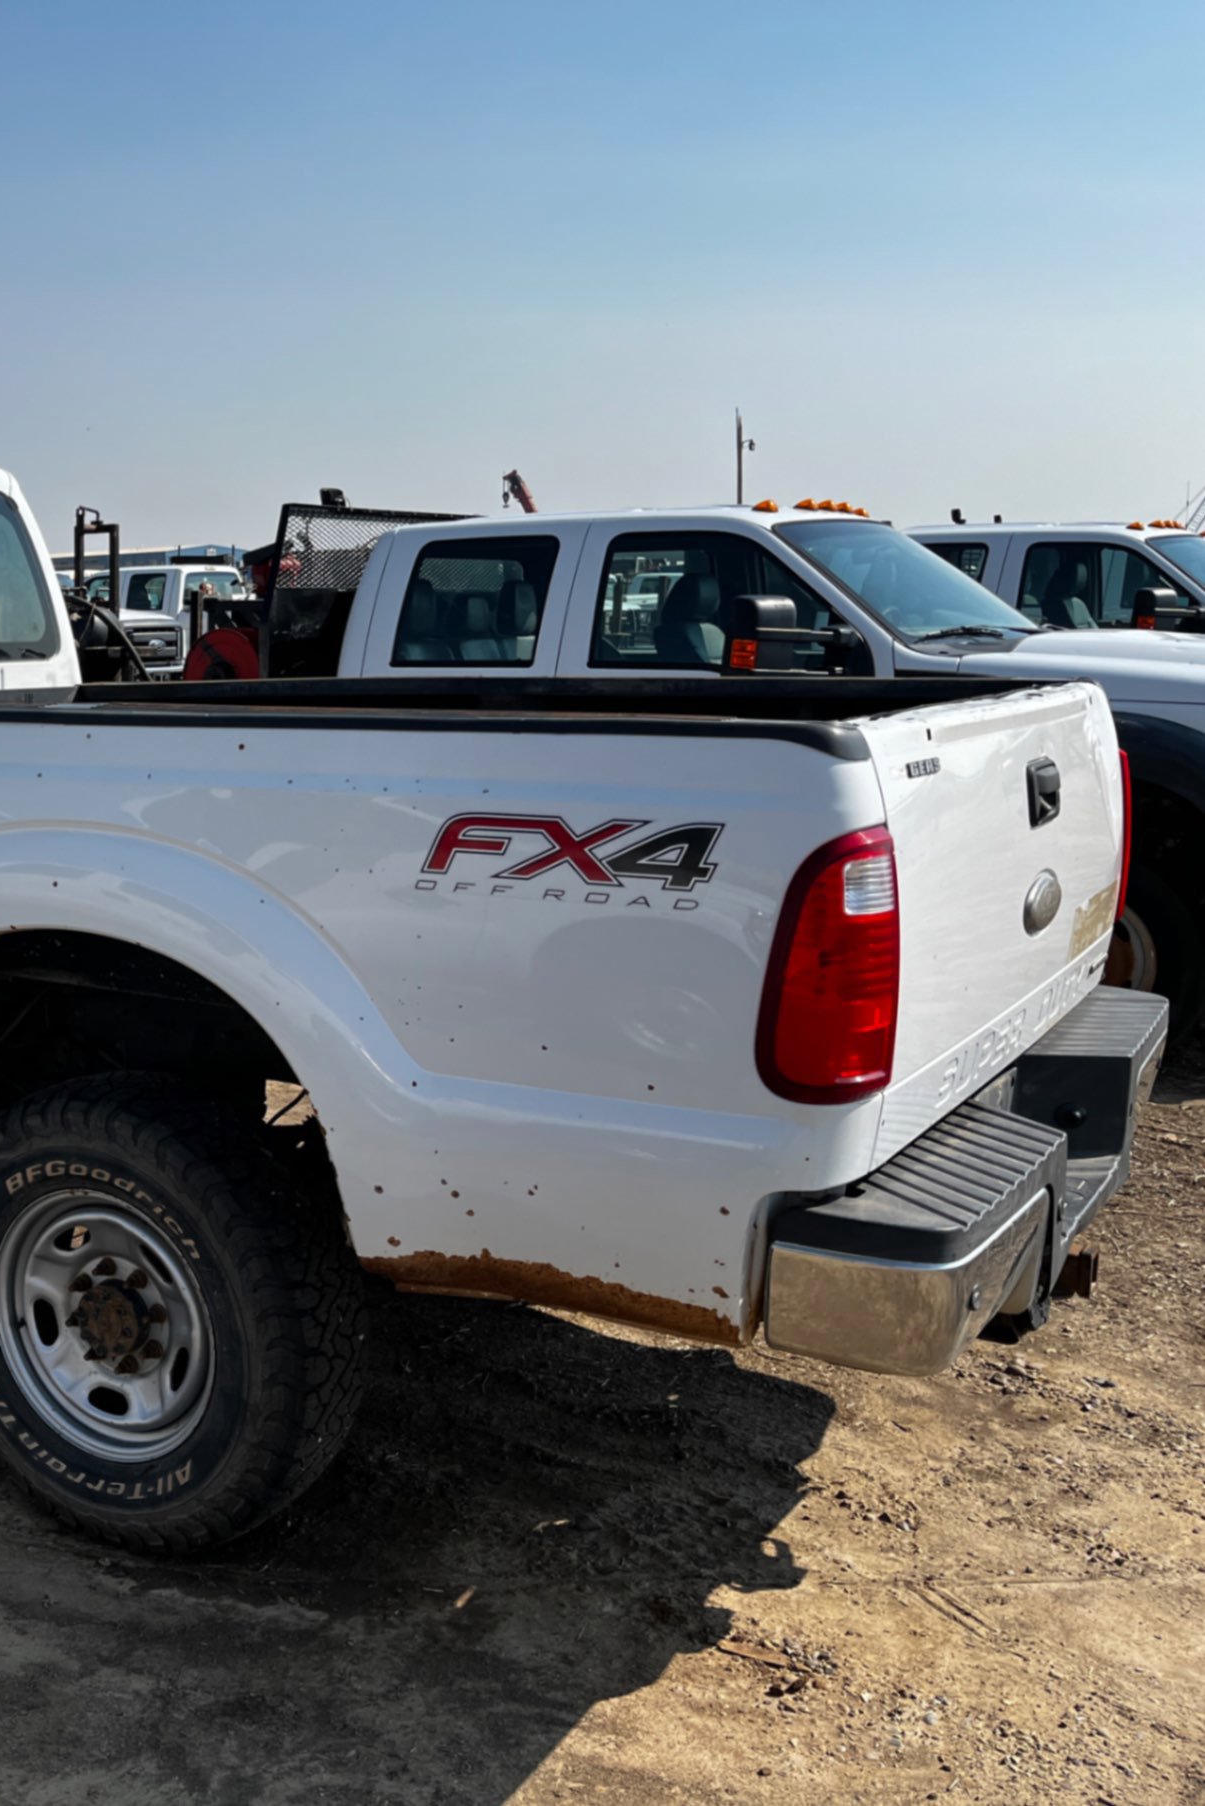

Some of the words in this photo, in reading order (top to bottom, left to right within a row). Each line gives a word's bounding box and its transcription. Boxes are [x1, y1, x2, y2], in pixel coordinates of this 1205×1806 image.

[421, 812, 725, 892] FX4
[935, 1008, 1027, 1109] SUPER
[5, 1160, 201, 1261] BFGoodrich
[19, 1431, 192, 1499] All-Terrain
